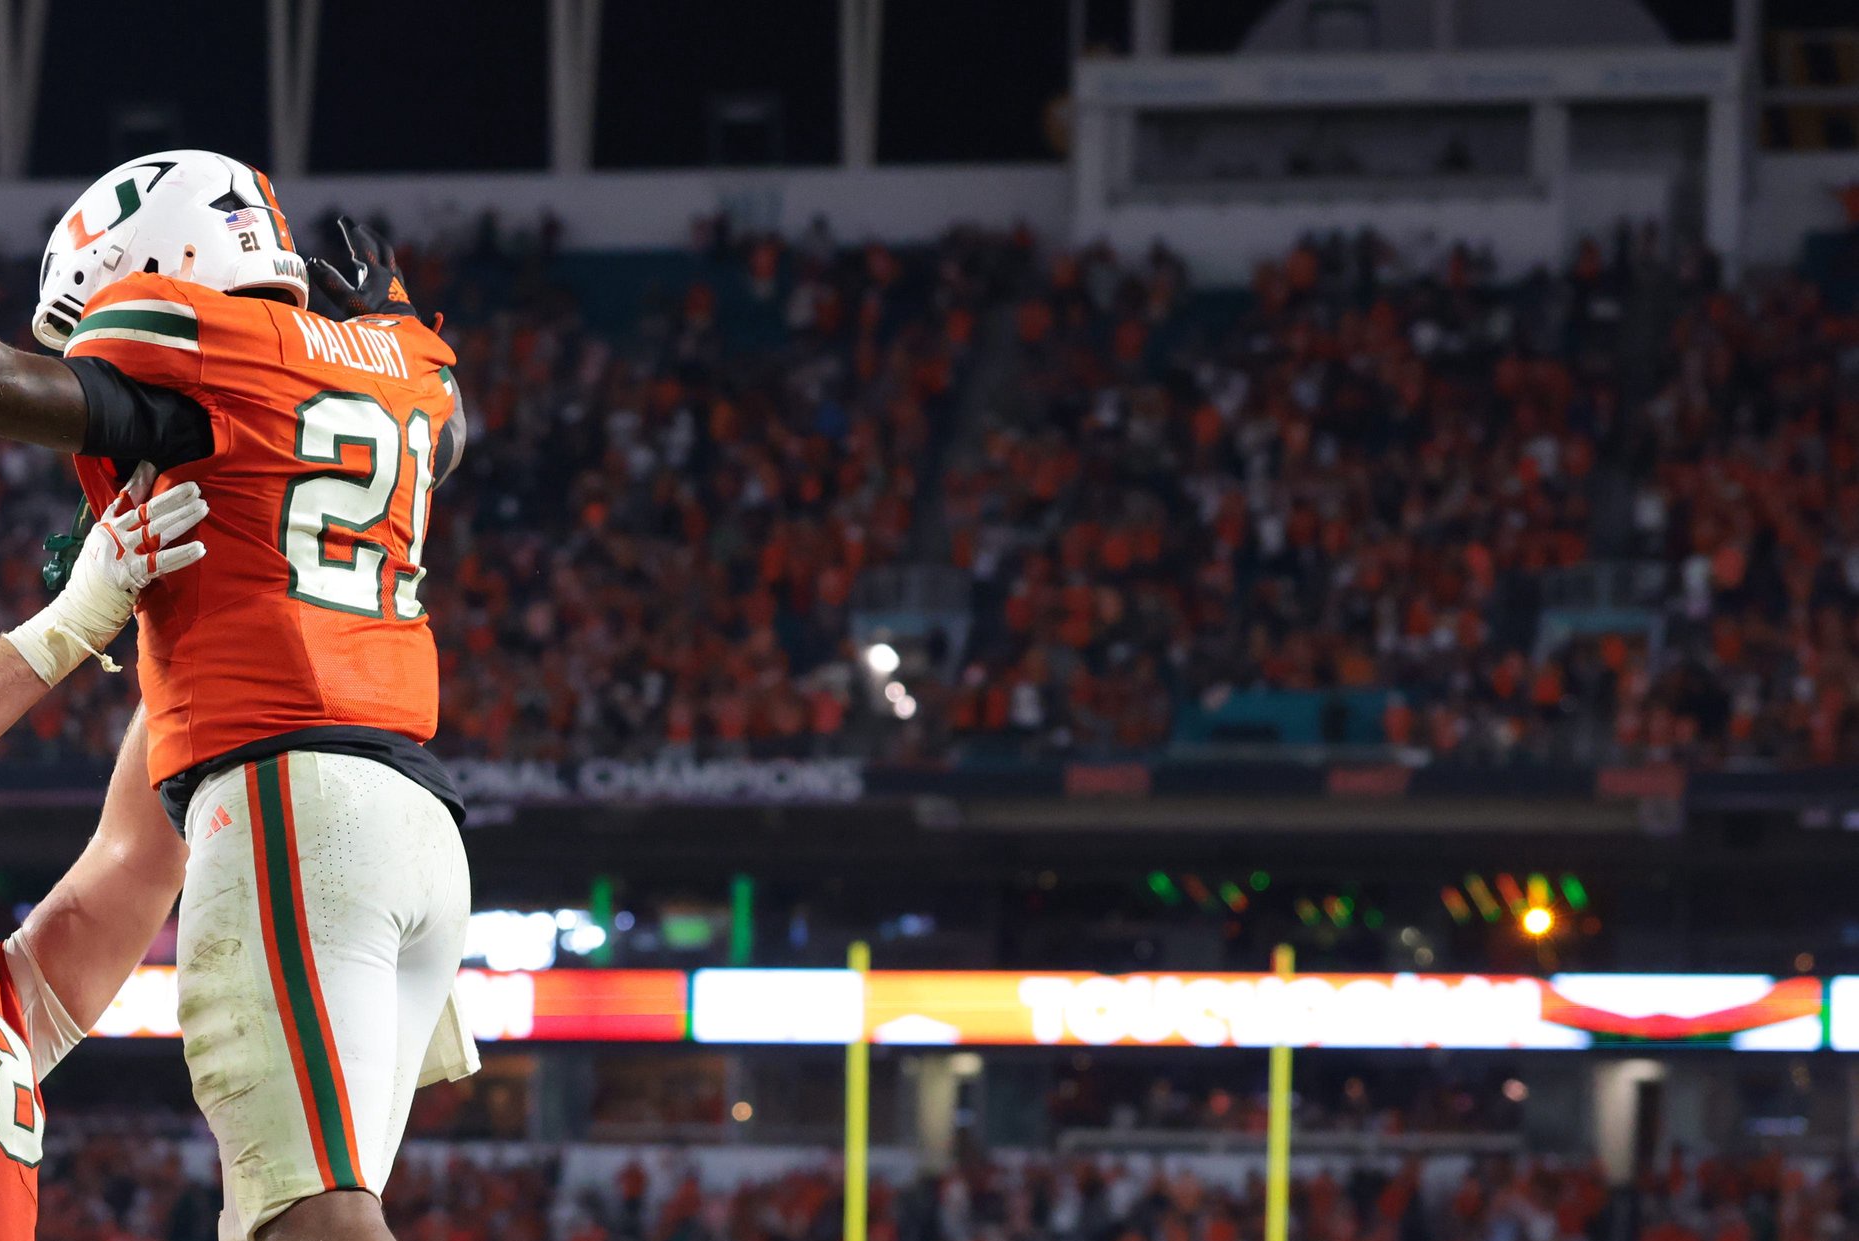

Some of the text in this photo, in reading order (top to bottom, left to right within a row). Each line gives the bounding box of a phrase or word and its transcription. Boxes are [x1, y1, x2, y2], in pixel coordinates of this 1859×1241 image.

[238, 231, 261, 252] 21
[292, 310, 409, 380] MALLORY
[278, 390, 433, 620] 21
